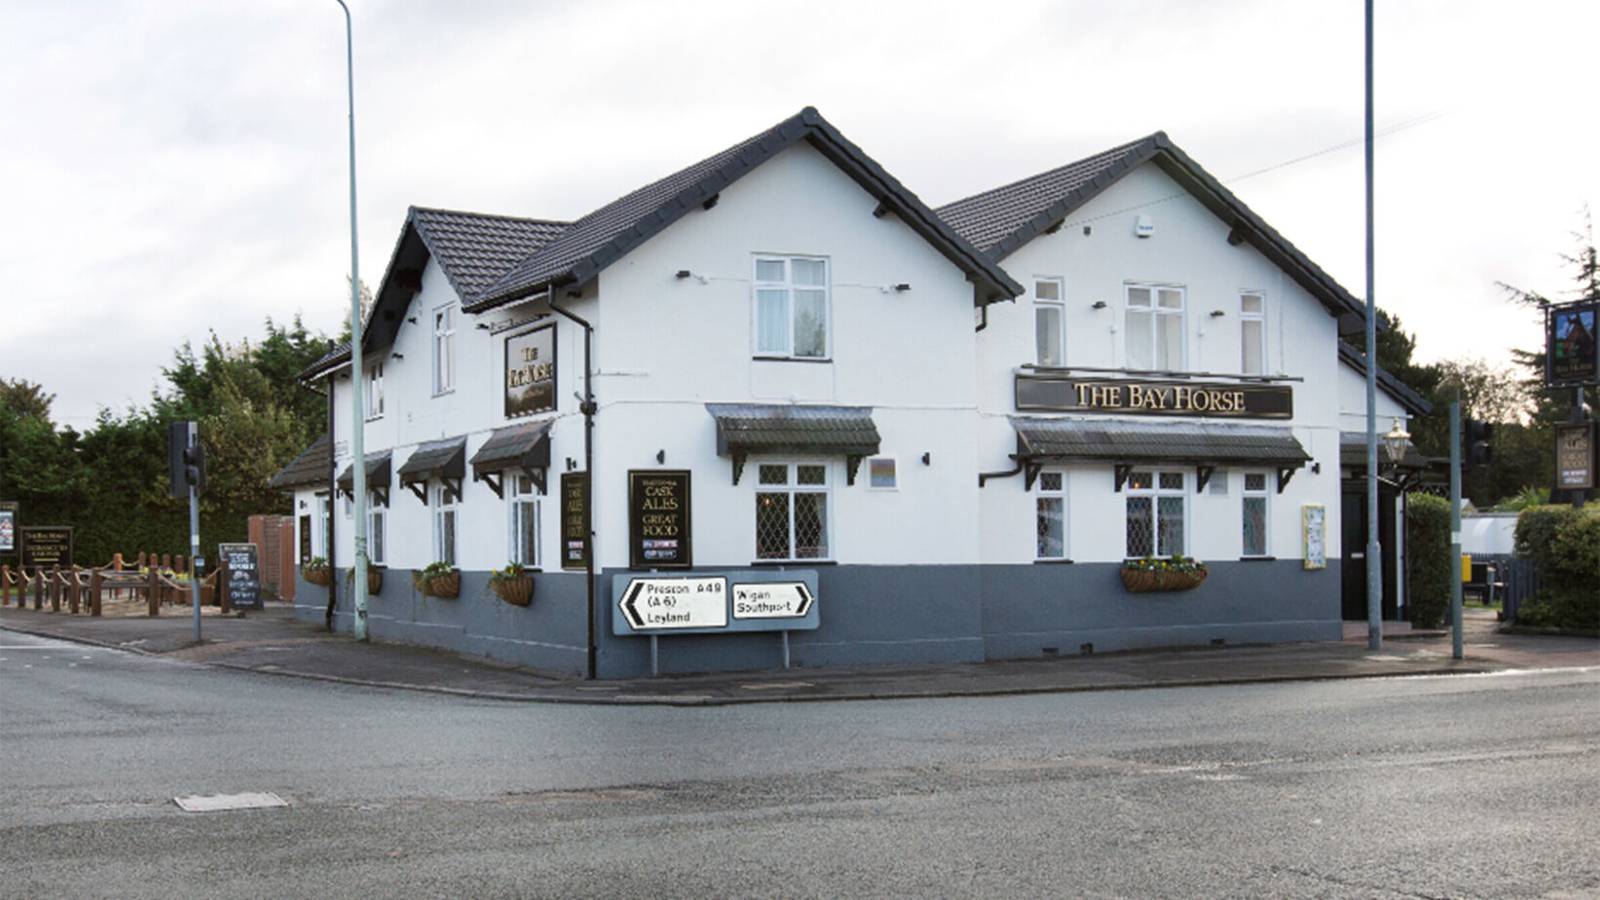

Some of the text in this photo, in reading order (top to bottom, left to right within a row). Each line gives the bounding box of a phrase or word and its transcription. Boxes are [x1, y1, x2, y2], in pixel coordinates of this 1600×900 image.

[1072, 383, 1246, 411] THE BAY HORSE
[645, 486, 674, 496] CASK
[642, 498, 679, 510] ALES
[642, 514, 677, 525] GREAT
[643, 525, 679, 536] FOOD
[647, 583, 689, 594] Preston
[736, 590, 771, 602] Wigan
[737, 601, 792, 613] Southport
[647, 612, 691, 624] Leyland
